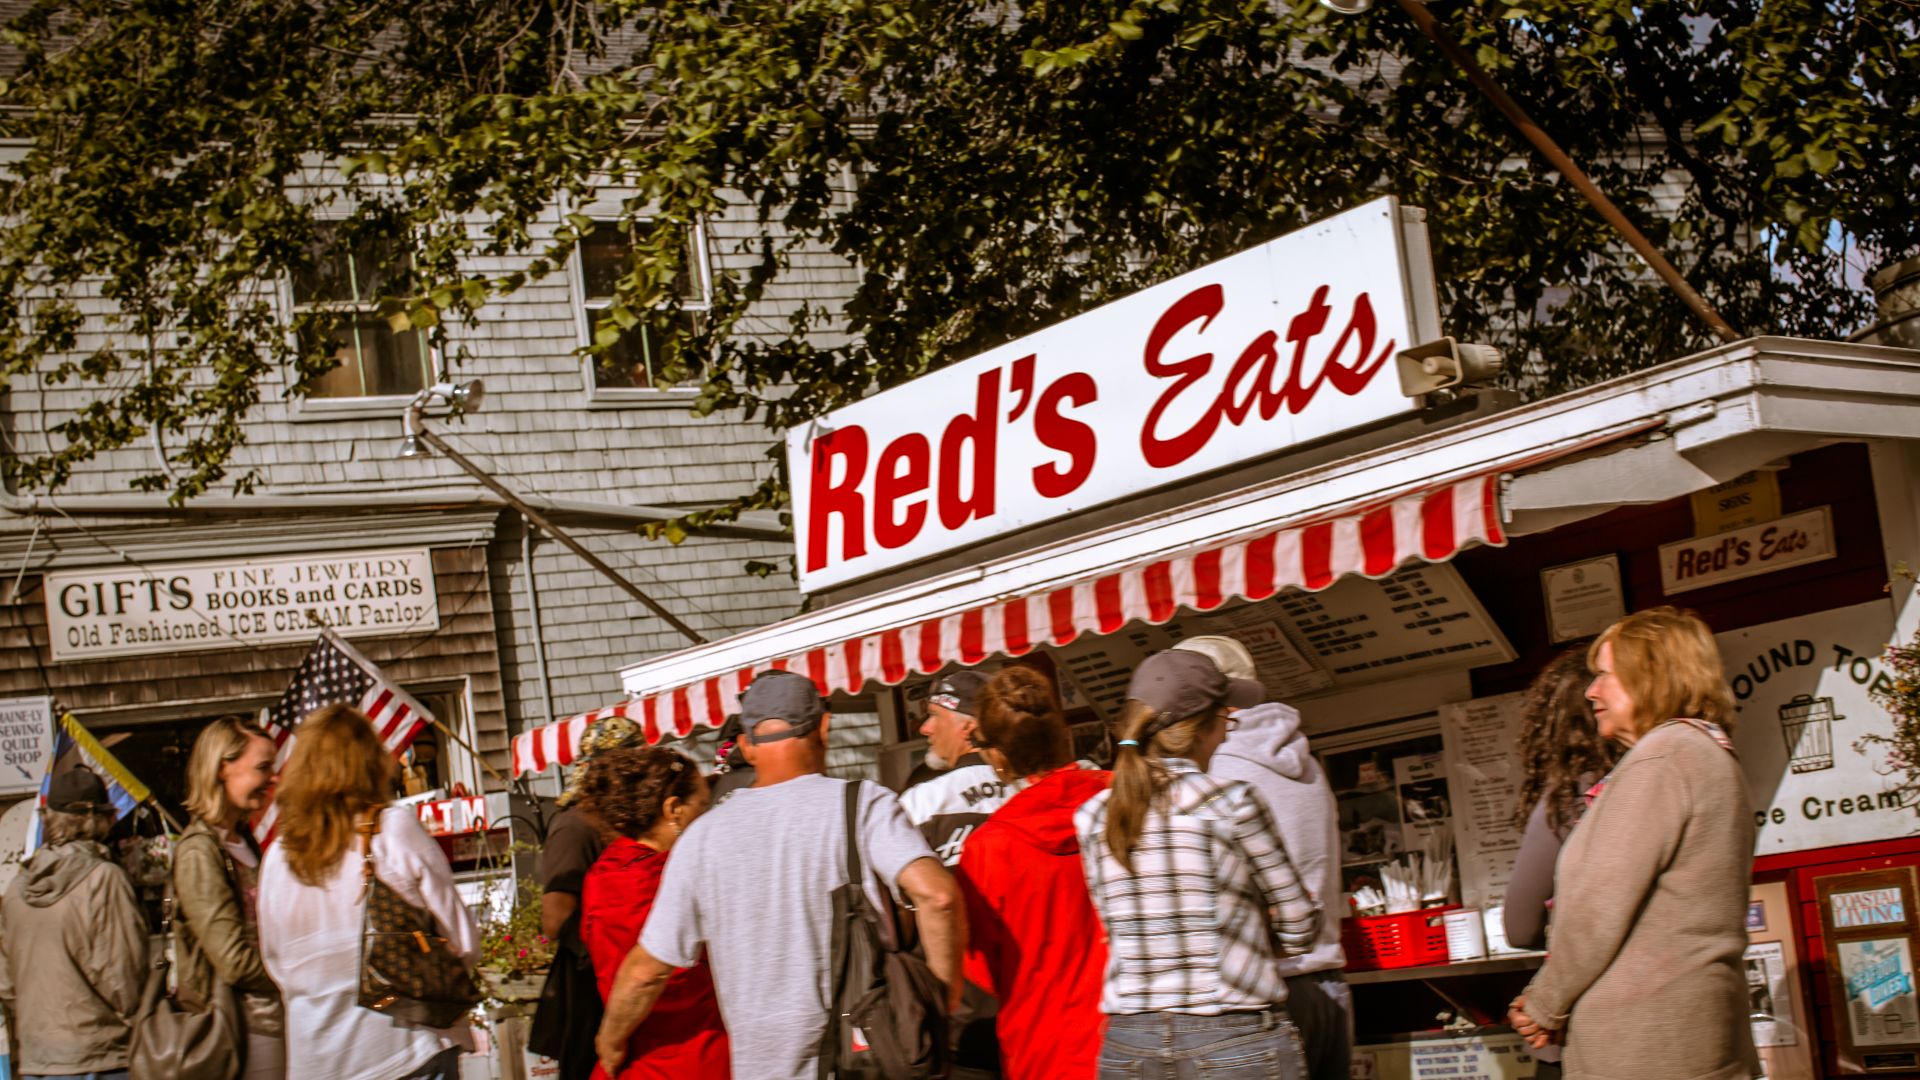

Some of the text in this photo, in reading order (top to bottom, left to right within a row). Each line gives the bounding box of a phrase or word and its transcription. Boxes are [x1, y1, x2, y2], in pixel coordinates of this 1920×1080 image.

[807, 283, 1396, 573] Red's Eats
[1676, 526, 1810, 581] Red's Eats
[213, 559, 412, 588] FINE JEWELRY
[60, 576, 193, 617] GIFTS
[206, 578, 423, 610] BOOKS and CARDS
[67, 624, 102, 648] Old
[108, 616, 222, 645] Fashioned
[229, 612, 267, 635] ICE
[358, 602, 423, 625] Parlor
[1732, 639, 1894, 706] OUND TOP
[2, 737, 39, 752] QUILT
[4, 751, 42, 766] SHOP
[420, 798, 485, 832] ATM
[1754, 790, 1900, 827] ce Cream
[1832, 888, 1902, 910] COASTAL
[1835, 903, 1904, 928] LIVING
